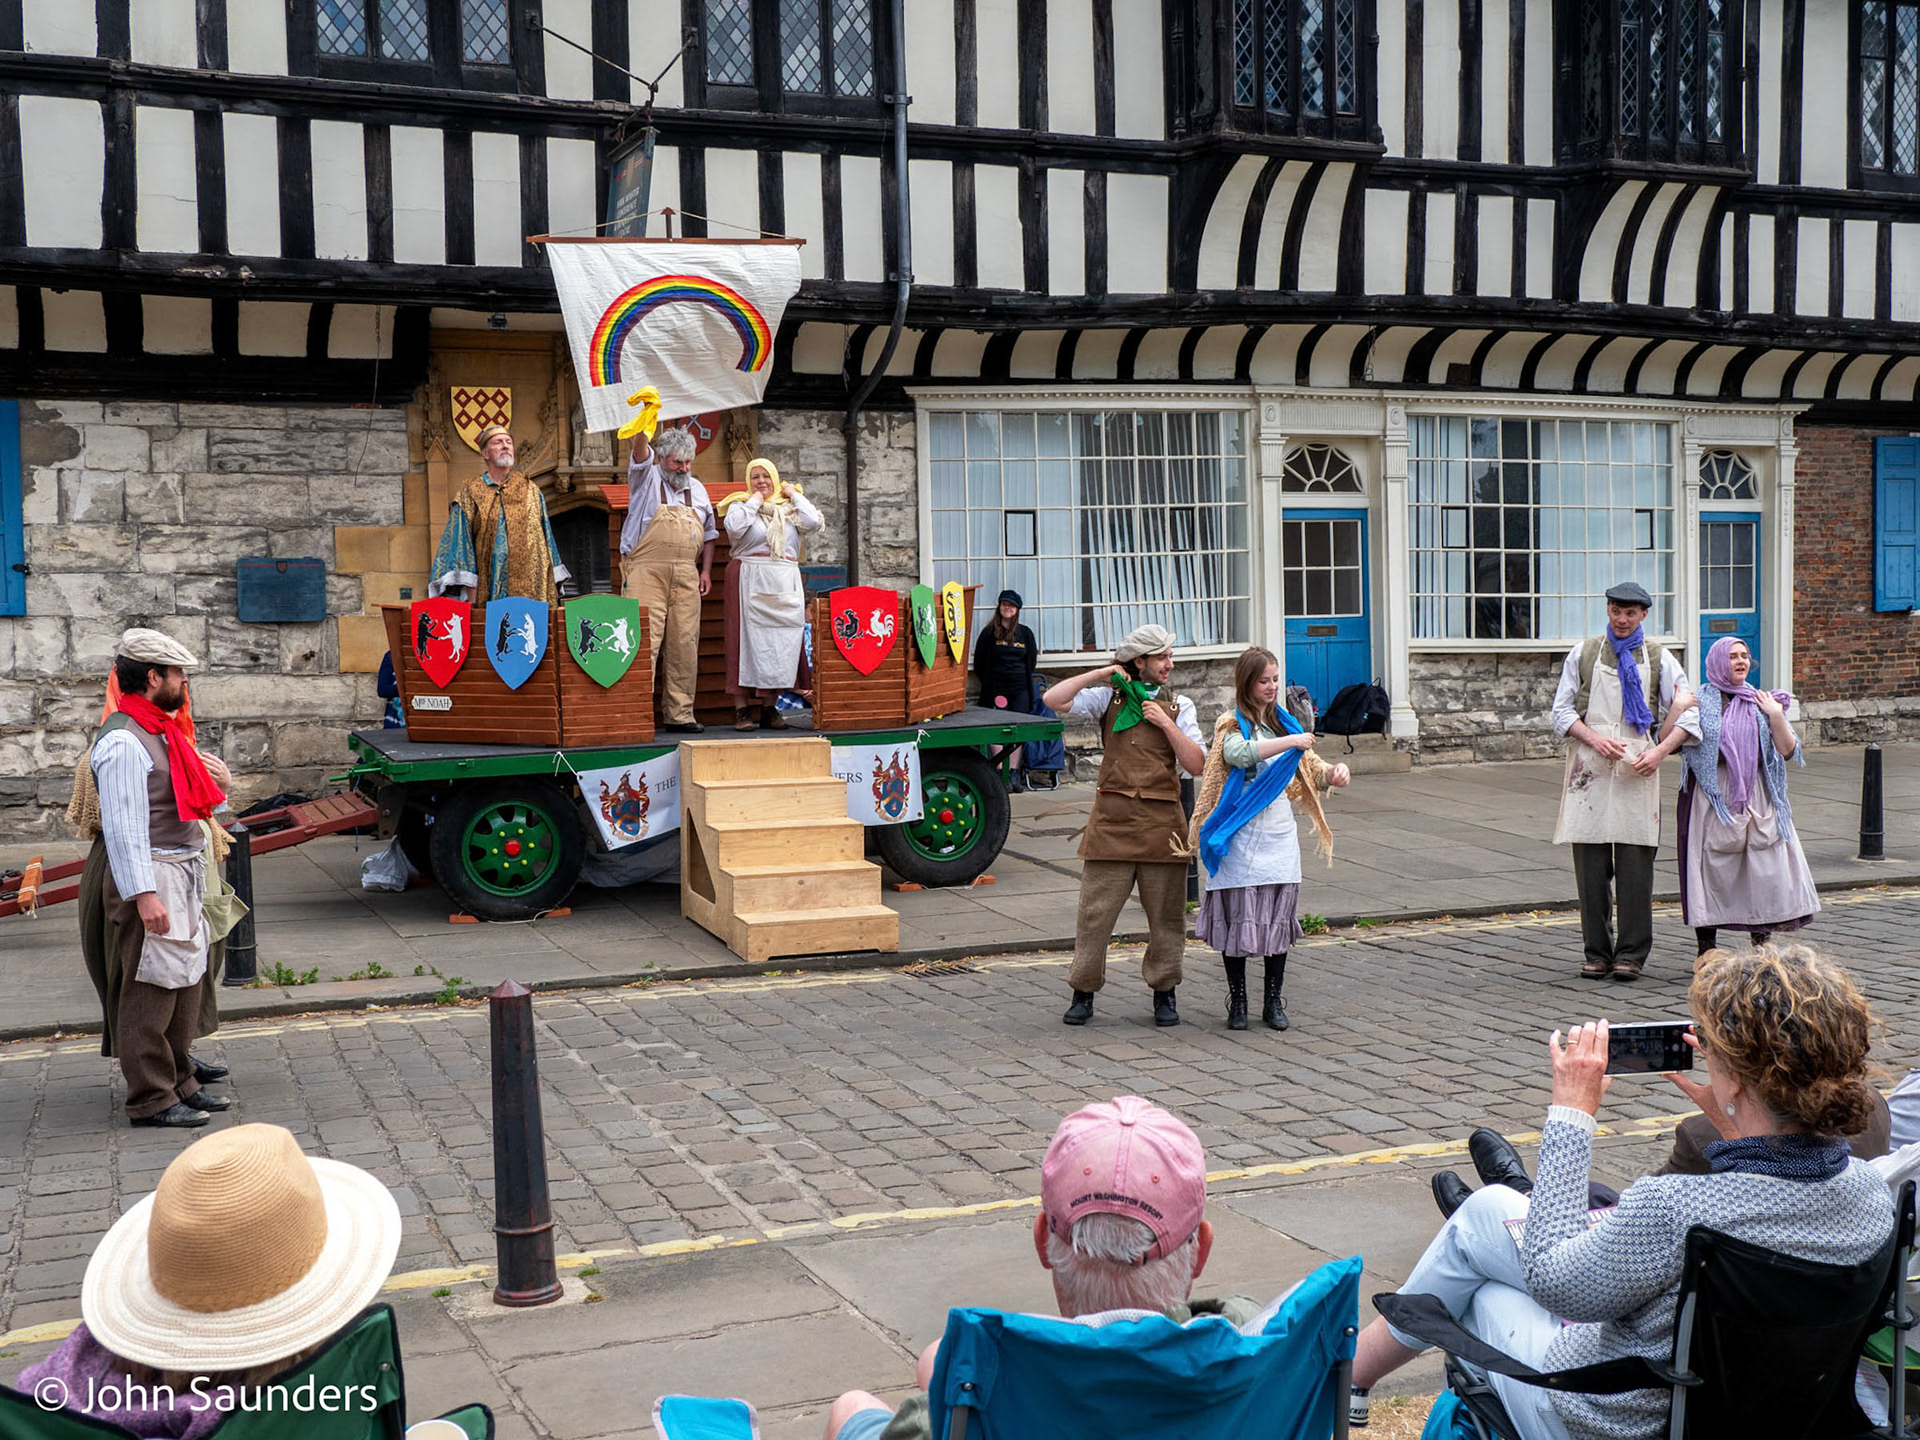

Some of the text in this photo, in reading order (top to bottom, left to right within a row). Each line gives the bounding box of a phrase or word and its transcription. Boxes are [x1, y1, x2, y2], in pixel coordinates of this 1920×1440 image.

[428, 697, 450, 709] NOAH
[655, 776, 677, 793] THE
[1069, 1192, 1164, 1220] MOUNT WASHINGTON RESORT
